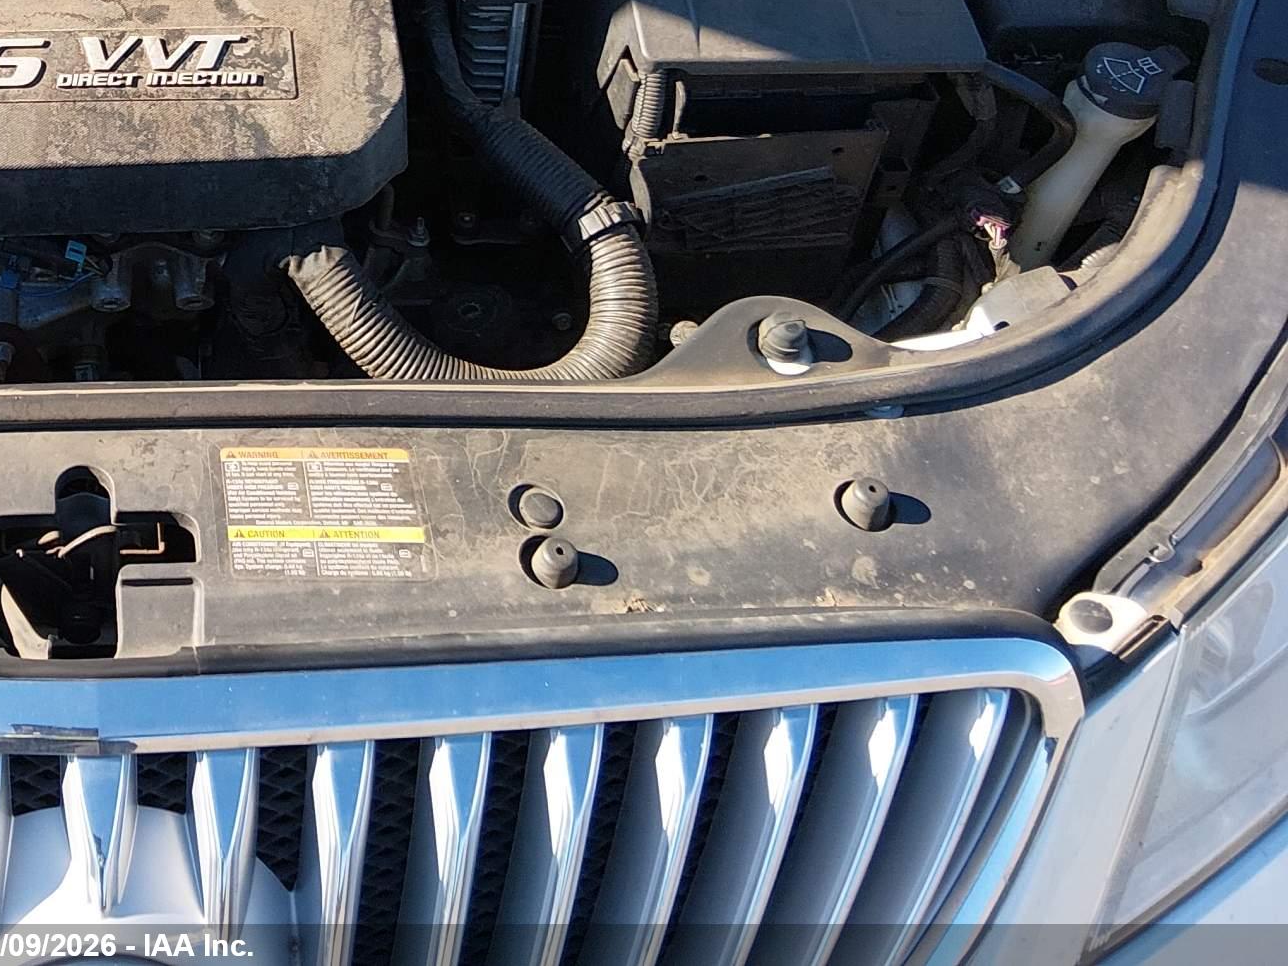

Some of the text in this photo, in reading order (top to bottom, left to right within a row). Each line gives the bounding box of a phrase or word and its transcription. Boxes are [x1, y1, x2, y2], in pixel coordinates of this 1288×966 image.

[82, 35, 248, 72] VVT
[56, 71, 264, 89] DIRECT INJECTION
[238, 451, 279, 459] WARNING
[320, 451, 388, 459] AVERTISSEMENT
[247, 530, 285, 538] CAUTION
[333, 530, 380, 539] ATTENTION
